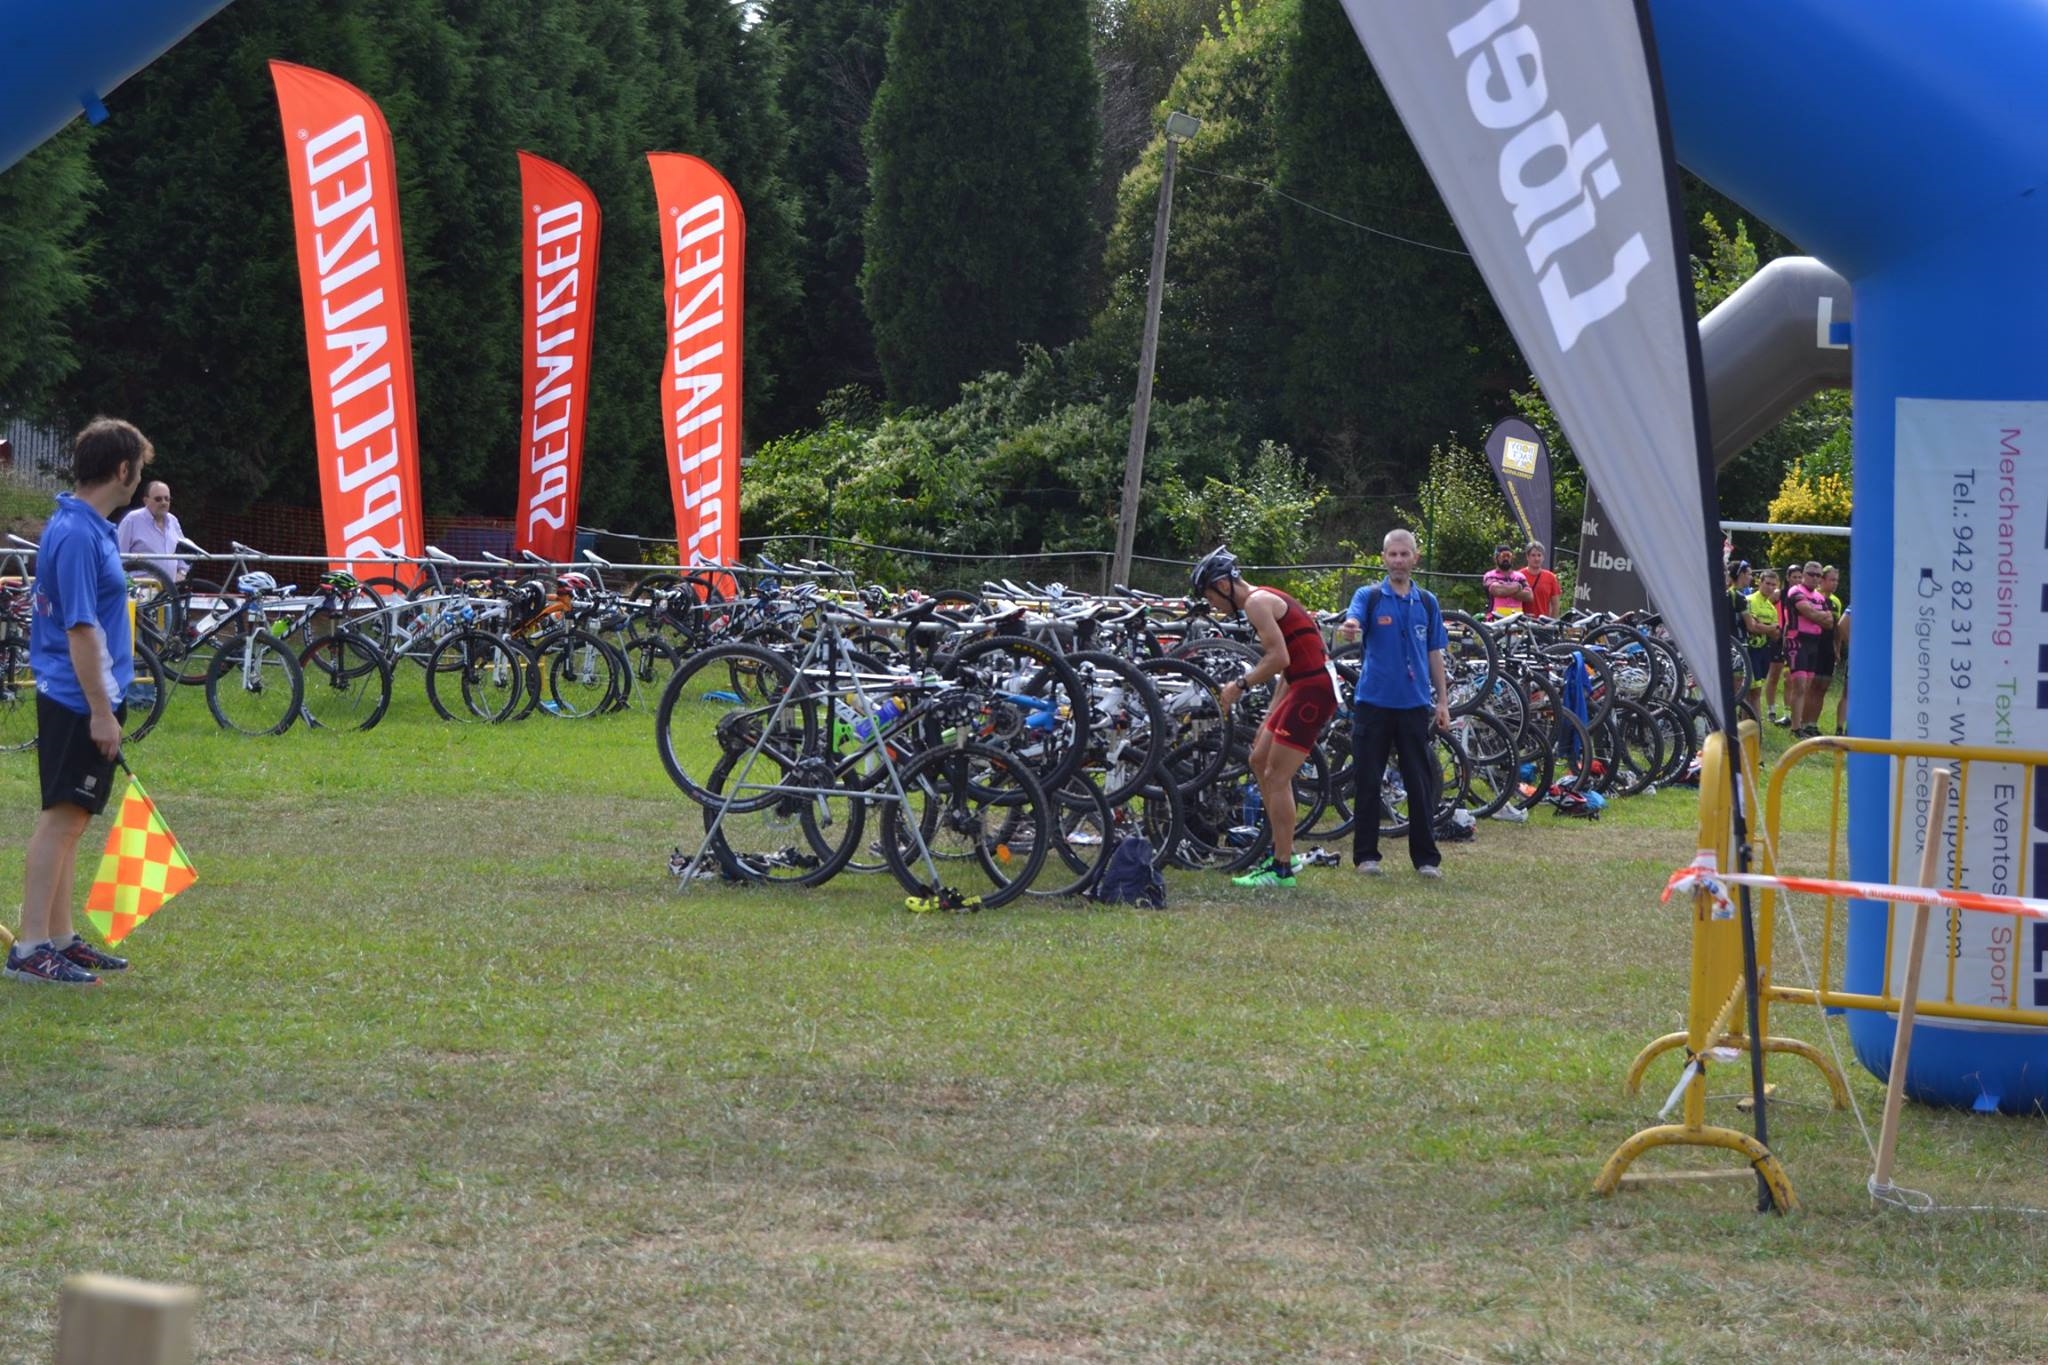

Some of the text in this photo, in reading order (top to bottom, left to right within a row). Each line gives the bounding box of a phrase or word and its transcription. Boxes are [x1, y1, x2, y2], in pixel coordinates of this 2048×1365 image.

[1952, 468, 1976, 518] Tel.:
[1951, 525, 1974, 573] 942
[1951, 581, 1973, 611] 82
[1951, 619, 1972, 647] 31
[1950, 657, 1972, 690] 39
[1914, 606, 1935, 854] Síguenos en acebook
[1986, 427, 2022, 1004] Merchandising Texti Eventos Sport
